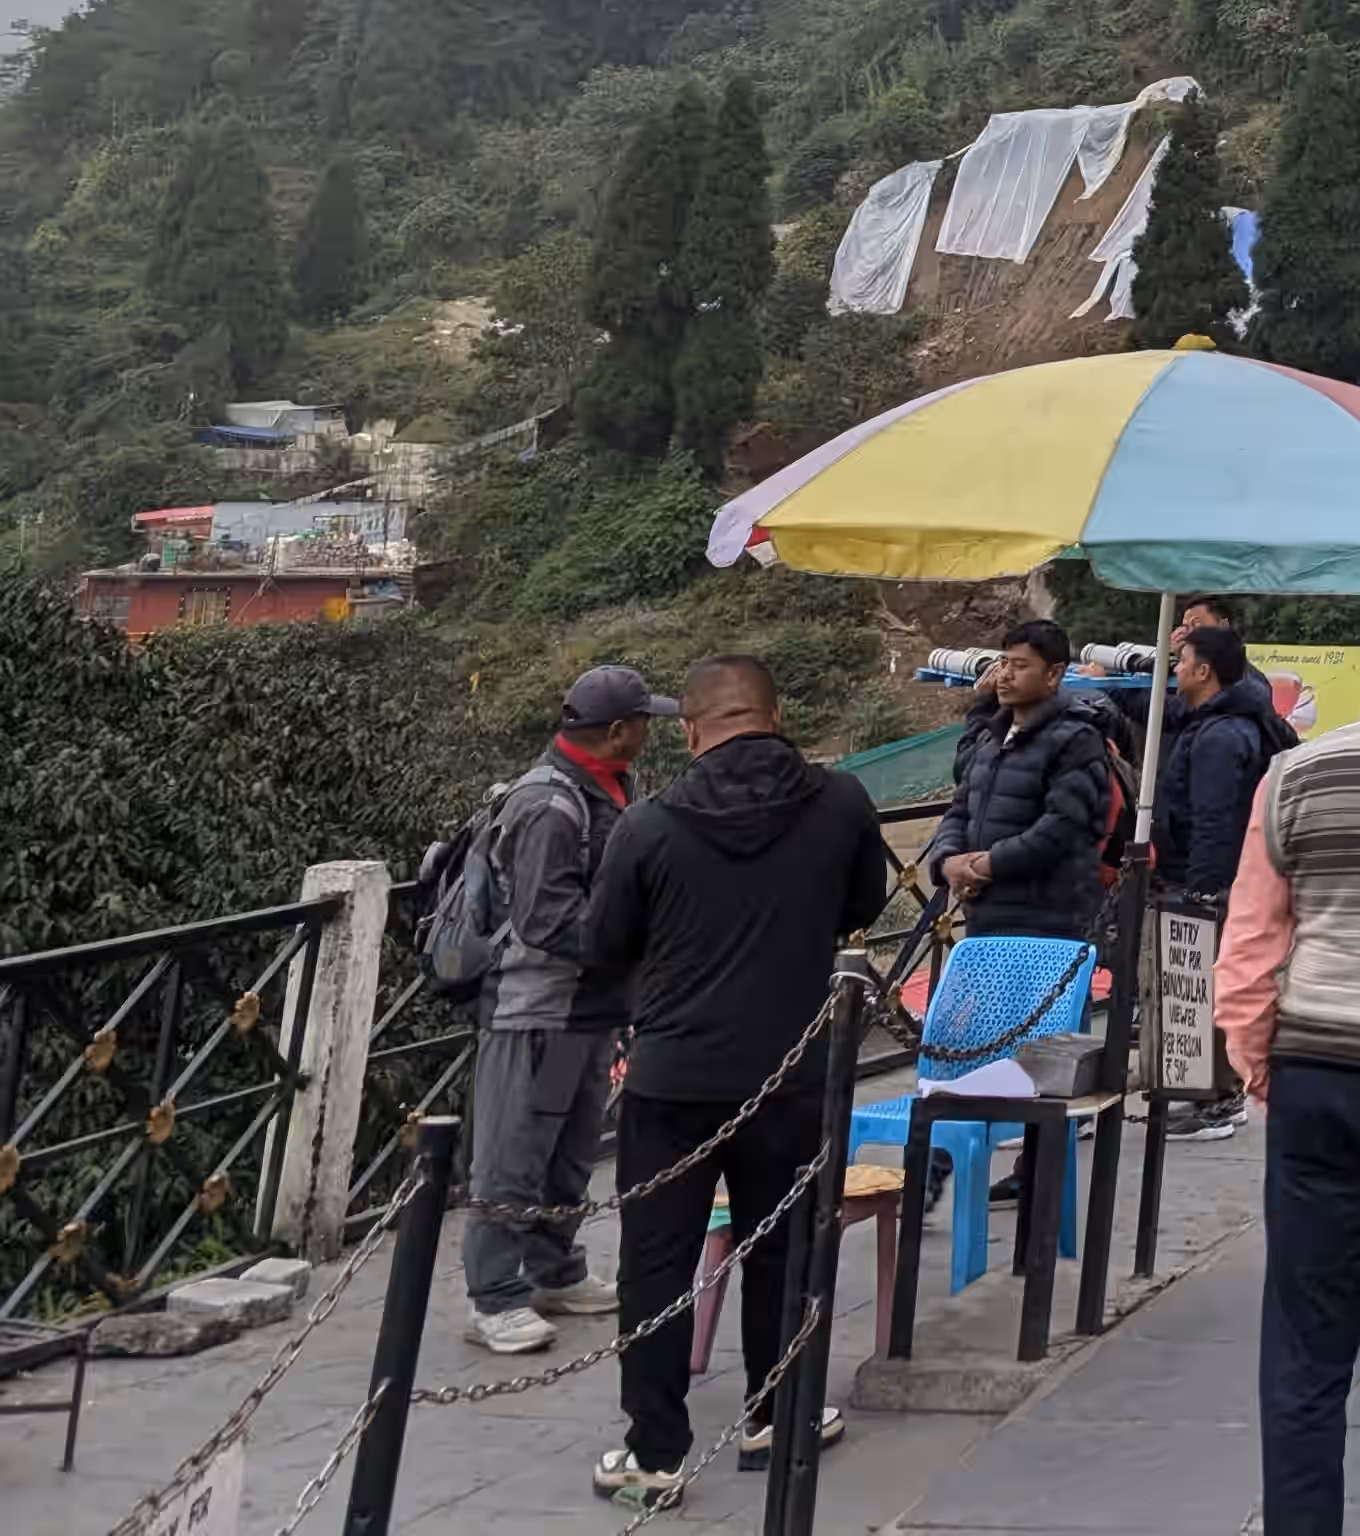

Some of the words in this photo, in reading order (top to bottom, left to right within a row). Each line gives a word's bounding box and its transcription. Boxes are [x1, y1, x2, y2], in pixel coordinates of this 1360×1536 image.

[1170, 920, 1199, 946] ENTRY
[1168, 946, 1188, 969] ONLY
[1189, 950, 1201, 970] FOR
[1163, 971, 1208, 1005] BINOCULAR
[1169, 1002, 1197, 1028] VIEWER
[1163, 1032, 1175, 1055] PER
[1176, 1032, 1201, 1057] PERSON
